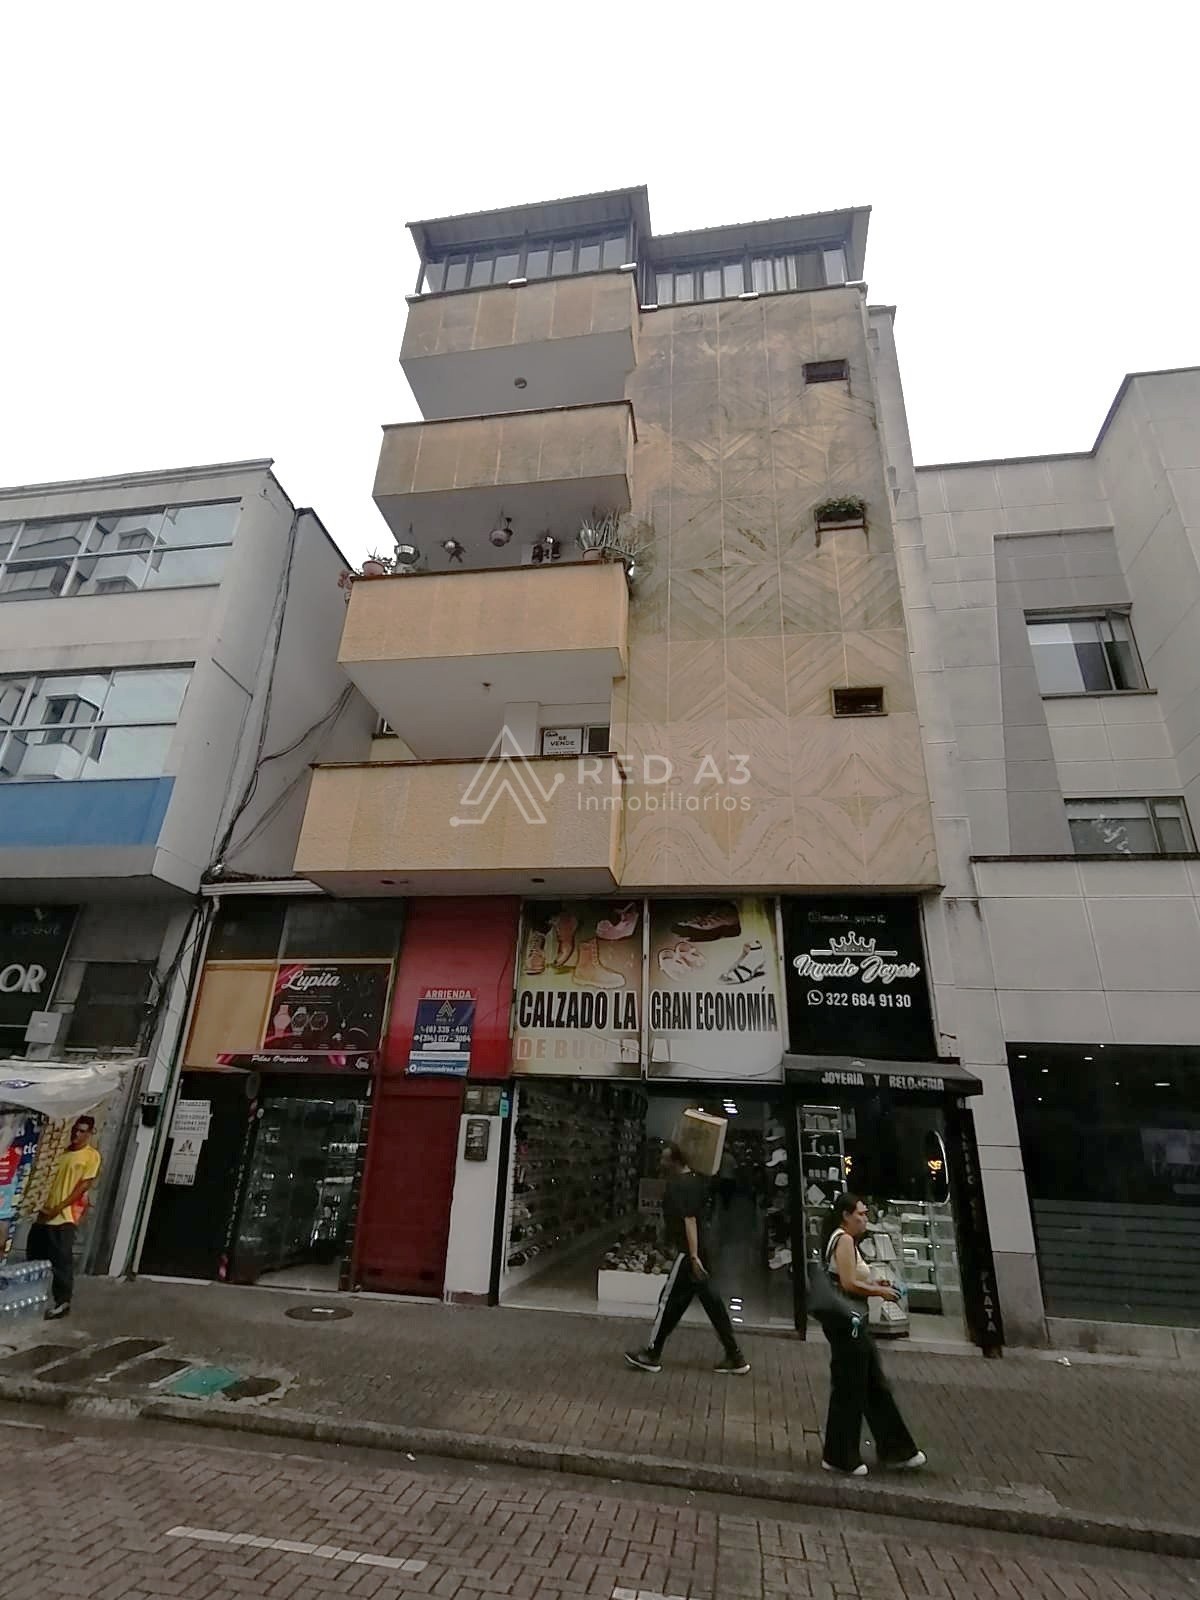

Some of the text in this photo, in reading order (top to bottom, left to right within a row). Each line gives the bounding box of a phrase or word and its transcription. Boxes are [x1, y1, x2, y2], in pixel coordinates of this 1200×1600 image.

[793, 953, 920, 984] Mundo Joyas
[280, 970, 341, 991] Lupita
[424, 989, 472, 999] ARRIENDA
[825, 992, 849, 1006] 322
[851, 993, 876, 1007] 684
[518, 986, 778, 1032] CALZADO LA GRAN ECONOMÍA
[518, 1038, 546, 1060] DE
[250, 1055, 271, 1063] Pilas
[821, 1071, 864, 1086] JOYERIA
[873, 1074, 881, 1087] Y
